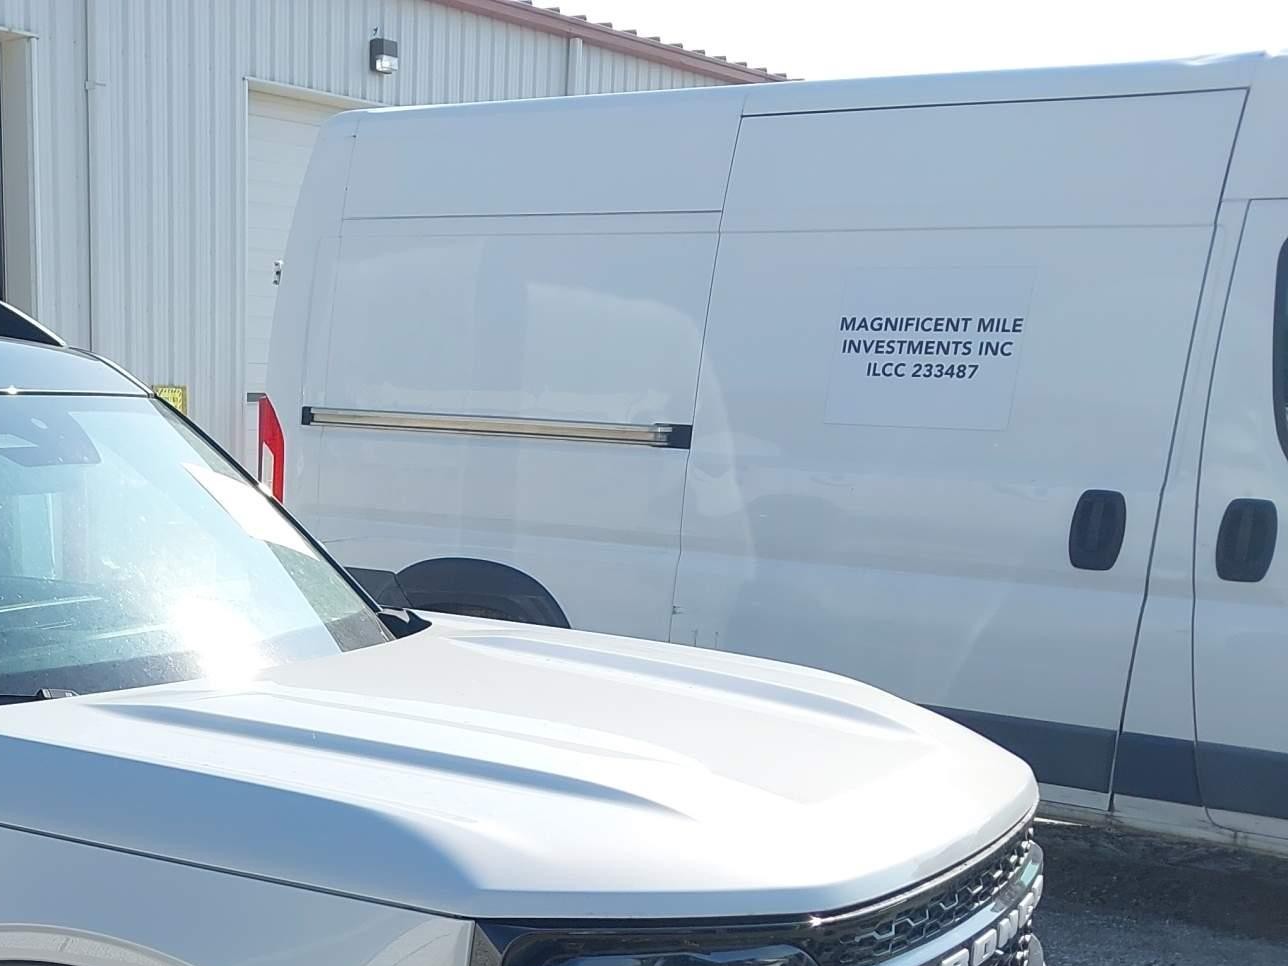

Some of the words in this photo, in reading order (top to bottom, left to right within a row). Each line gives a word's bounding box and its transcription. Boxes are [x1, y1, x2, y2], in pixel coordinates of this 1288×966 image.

[840, 316, 973, 333] MAGNIFICENT
[976, 317, 1024, 333] MILE
[841, 338, 973, 356] INVESTMENTS
[977, 340, 1014, 357] INC
[866, 362, 907, 378] ILCC
[911, 362, 980, 379] 233487
